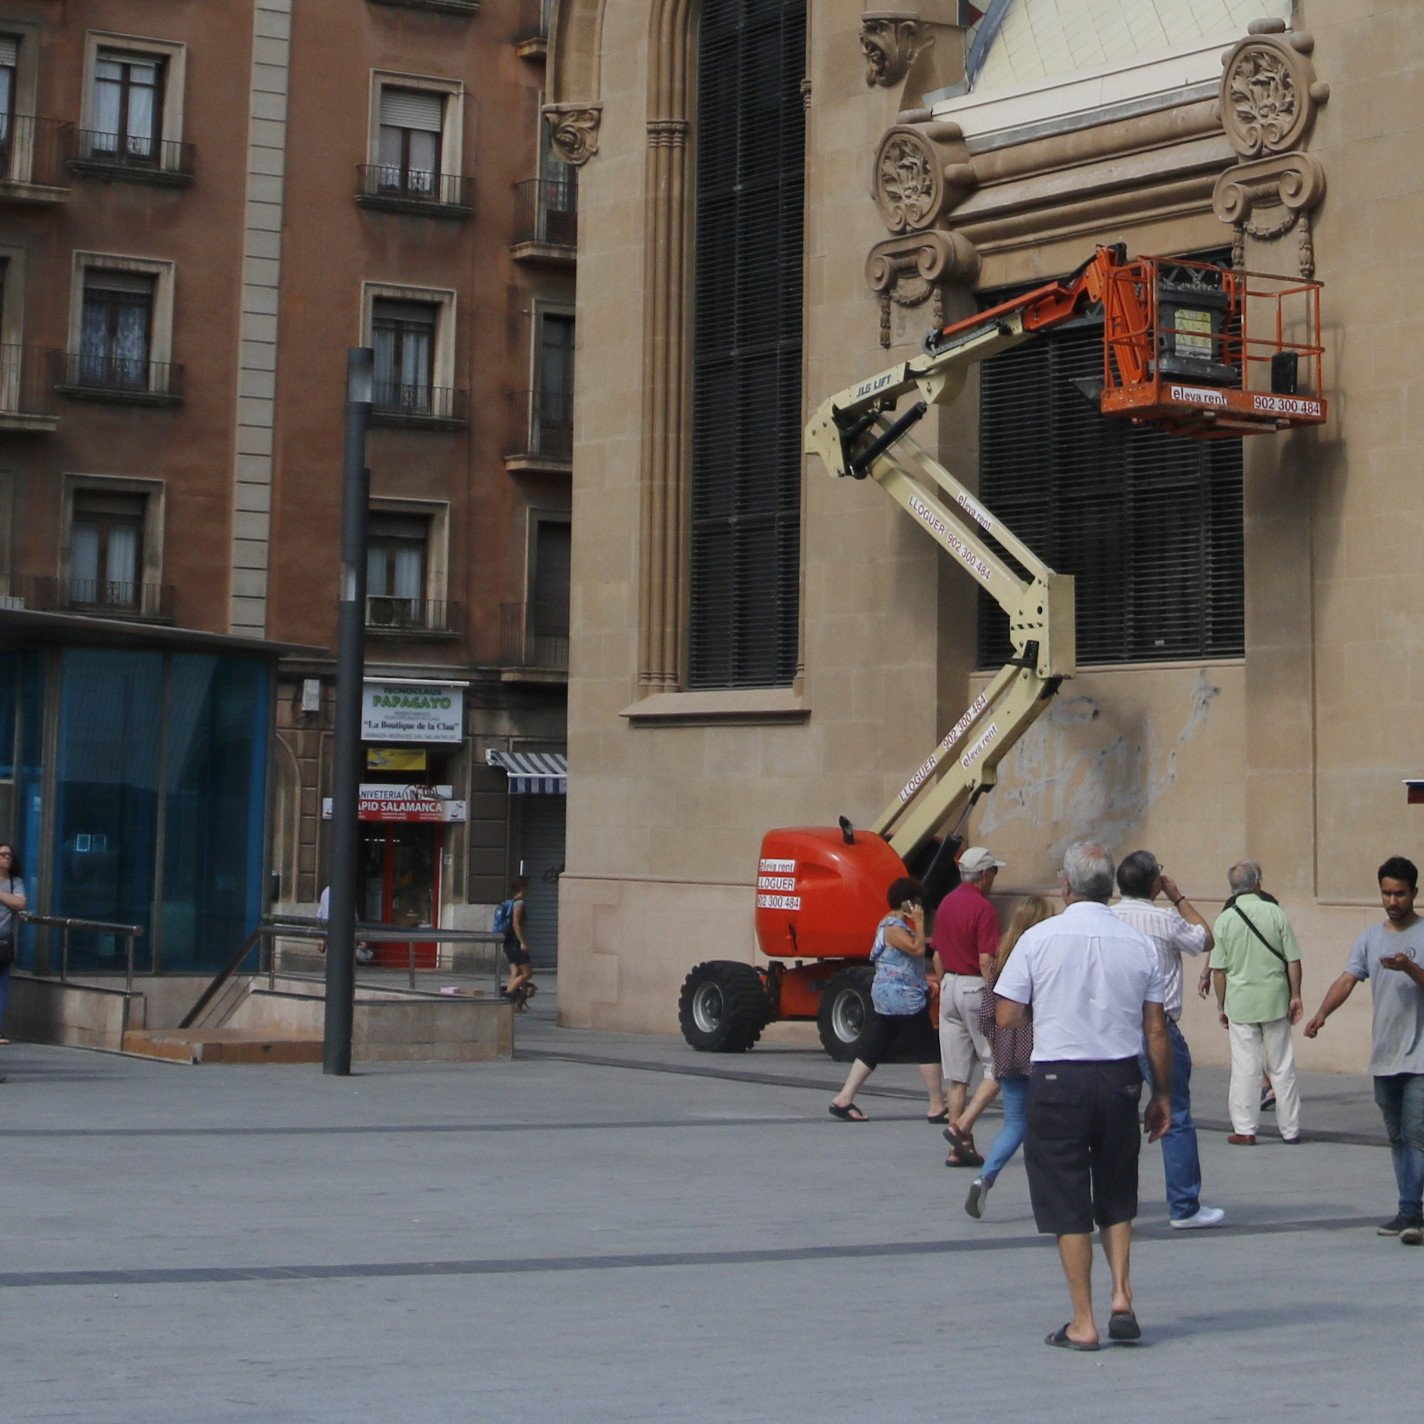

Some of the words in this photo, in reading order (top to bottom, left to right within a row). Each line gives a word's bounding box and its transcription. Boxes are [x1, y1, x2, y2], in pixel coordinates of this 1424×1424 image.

[856, 383, 871, 398] JLG
[874, 374, 892, 390] LIFT
[1173, 387, 1201, 402] eleva
[1204, 394, 1227, 406] rent
[1255, 396, 1275, 409] 902
[1278, 400, 1297, 412] 300
[1301, 402, 1320, 414] 484
[958, 495, 976, 518] eleva
[976, 513, 992, 531] rent
[909, 496, 946, 534] LLOGUER
[947, 534, 962, 552] 902
[961, 547, 976, 566] 300
[976, 561, 991, 579] 484
[373, 695, 451, 709] PAPAGAYO
[381, 721, 414, 731] Boutique
[417, 722, 425, 730] de
[899, 755, 936, 802] LLOGUER
[943, 729, 957, 750] 902
[958, 712, 972, 733] 300
[973, 695, 987, 714] 484
[963, 746, 982, 767] eleva
[982, 725, 998, 745] rent
[359, 790, 403, 799] NIVETERIA
[381, 802, 442, 812] SALAMANCA
[758, 877, 794, 890] LOGUER
[768, 896, 783, 907] 300
[785, 897, 799, 908] 484
